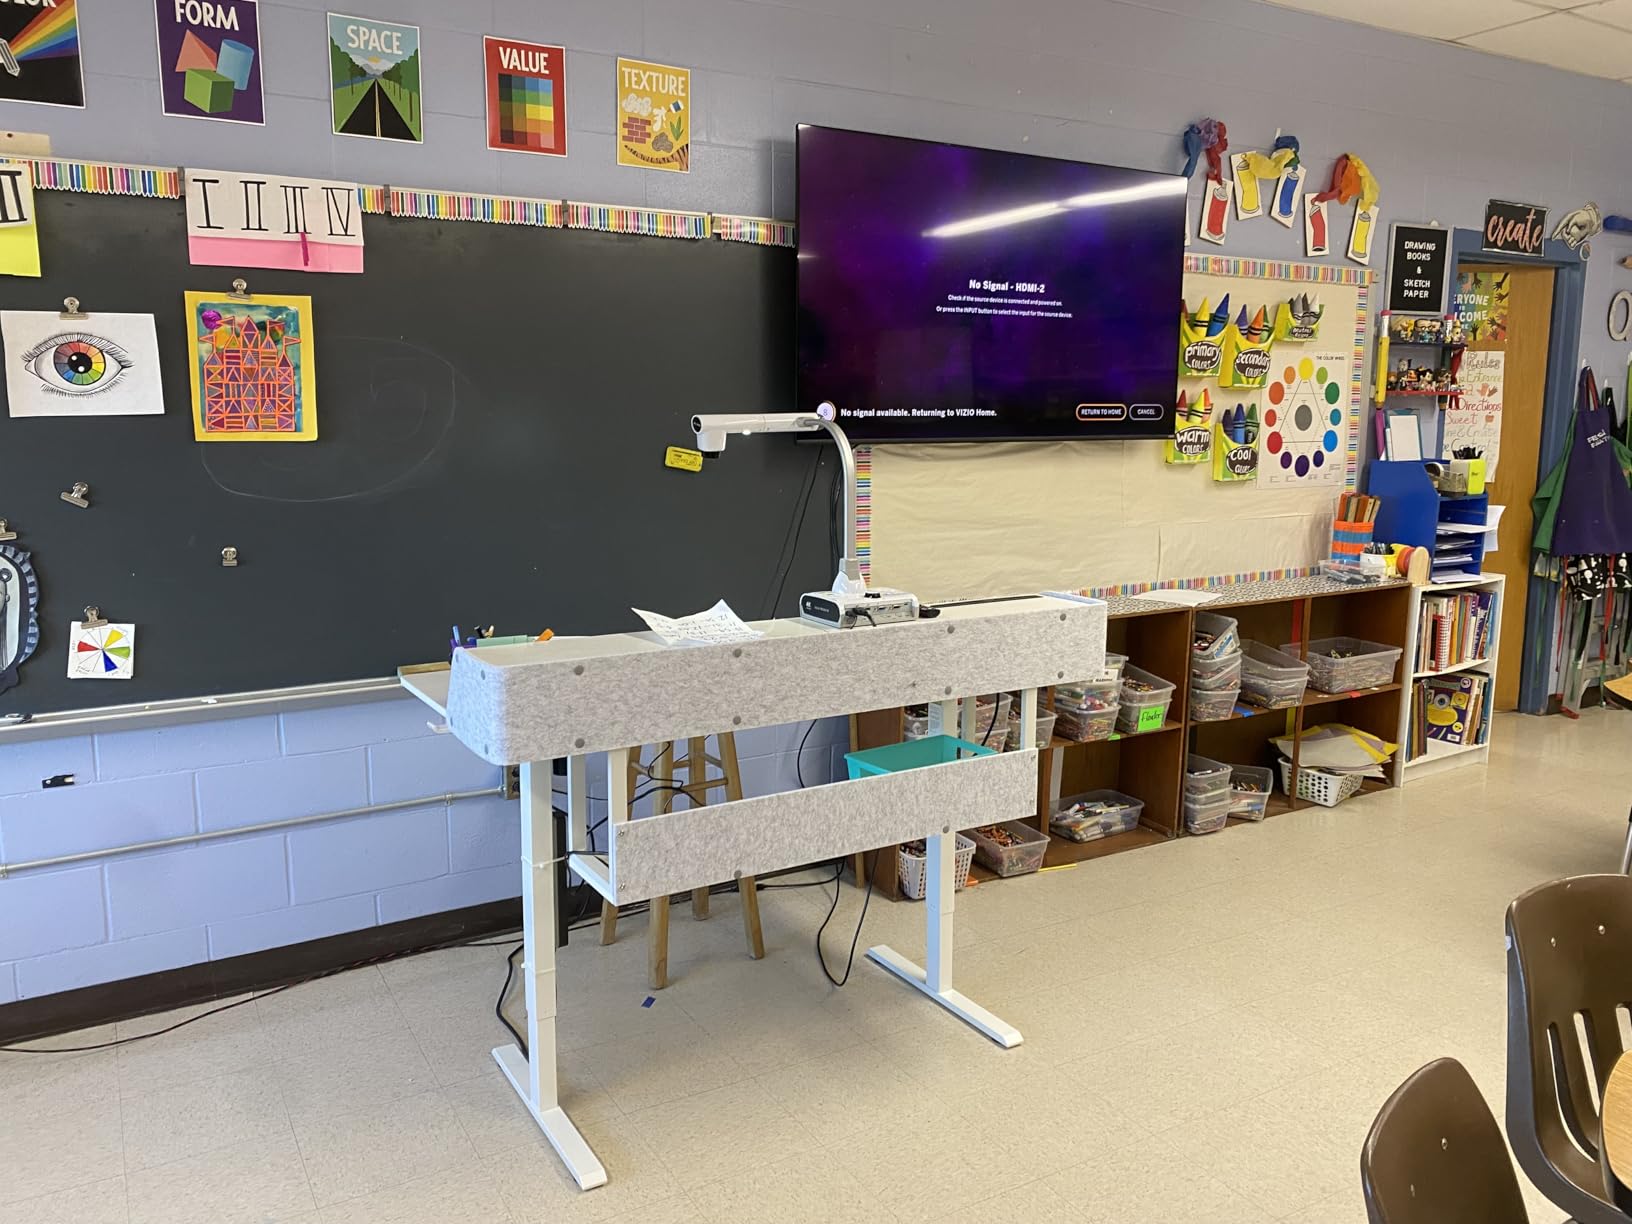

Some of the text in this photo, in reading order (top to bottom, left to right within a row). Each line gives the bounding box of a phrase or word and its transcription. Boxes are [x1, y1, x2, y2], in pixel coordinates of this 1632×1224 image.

[174, 0, 239, 30] FORM
[346, 24, 403, 55] SPACE
[499, 46, 550, 74] VALUE
[622, 67, 686, 96] TEXTURE
[1487, 208, 1543, 252] create
[1404, 241, 1436, 250] DRAWING
[1406, 252, 1430, 261] BOOKS
[969, 279, 980, 289] No
[983, 280, 1008, 291] Signal
[1016, 283, 1045, 293] HDMI-2
[1404, 279, 1430, 287] SKETCH
[1403, 290, 1429, 298] PAPER
[1454, 294, 1489, 305] RYONE
[1185, 342, 1221, 362] primary
[1458, 397, 1502, 411] Directions
[853, 408, 875, 418] signal
[876, 408, 910, 417] available.
[912, 408, 946, 418] Returning
[976, 409, 997, 417] Home.
[1447, 411, 1478, 424] Sweet
[1176, 430, 1210, 443] warm
